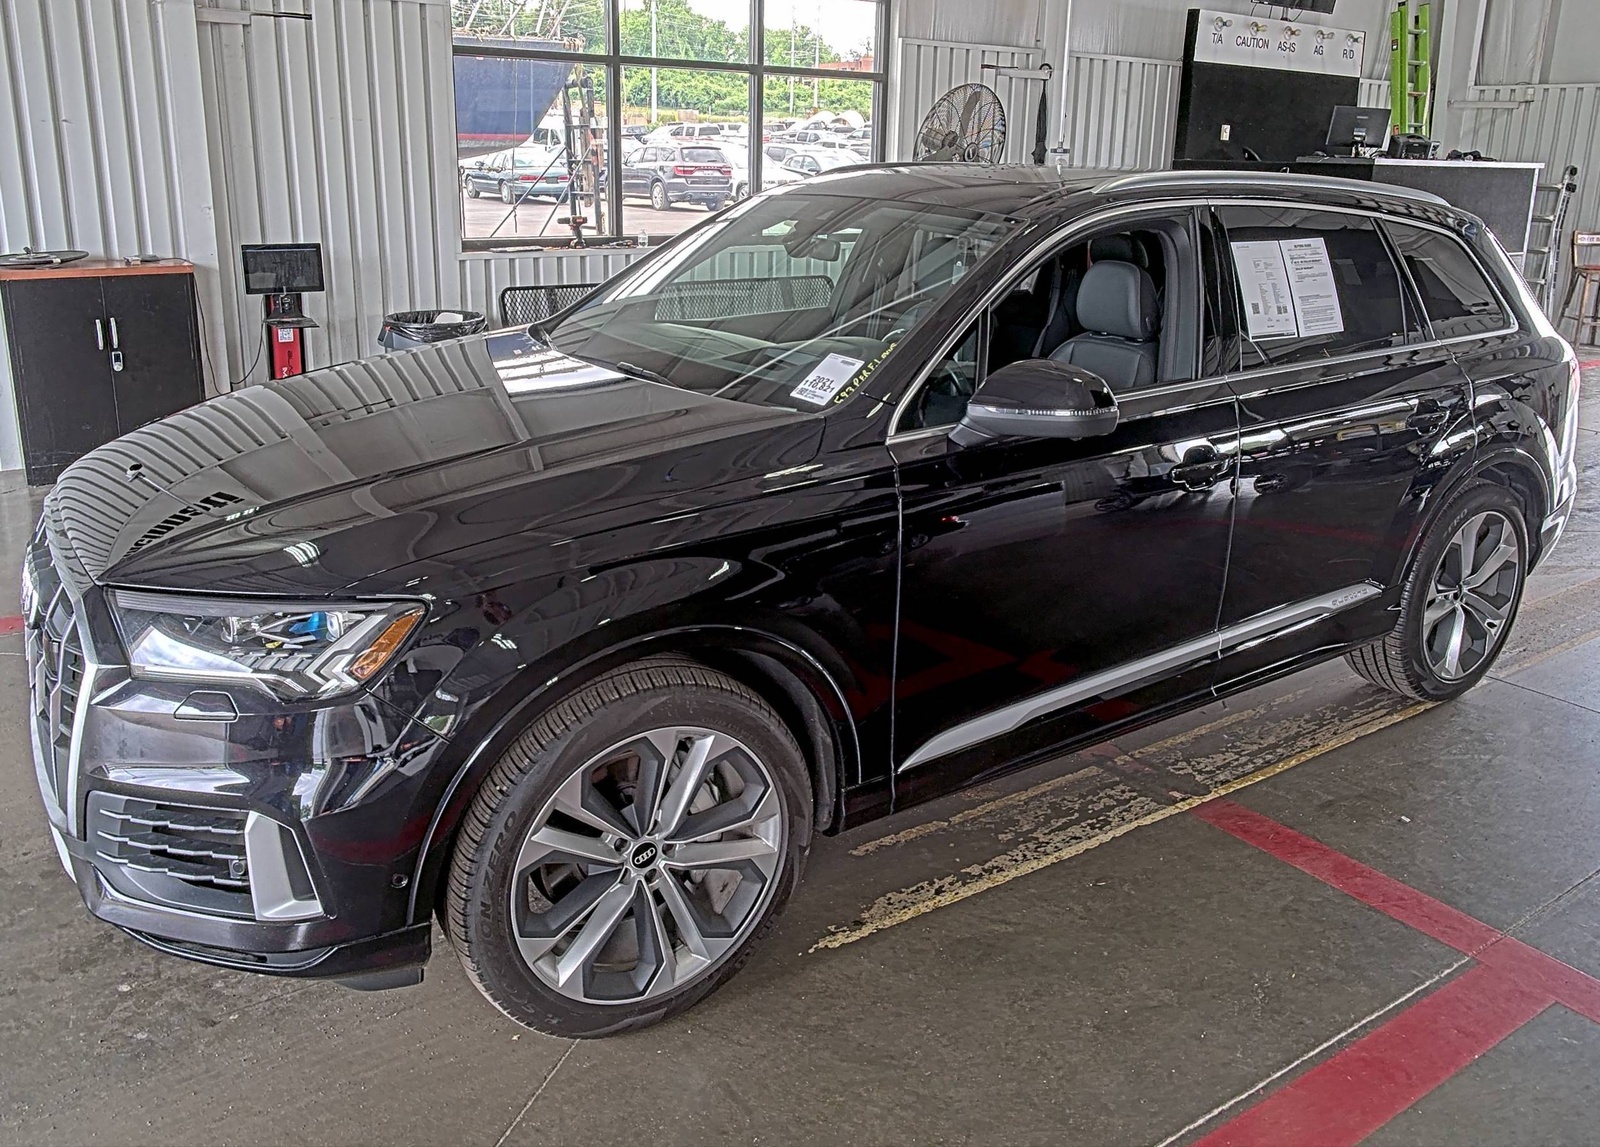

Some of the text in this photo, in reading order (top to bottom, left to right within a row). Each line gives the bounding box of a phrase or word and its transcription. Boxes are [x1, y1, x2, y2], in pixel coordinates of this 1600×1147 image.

[1211, 32, 1223, 45] T/A
[1235, 35, 1270, 50] CAUTION
[1276, 41, 1297, 53] AS-IS
[1313, 45, 1324, 56] AG
[813, 375, 835, 385] 2021
